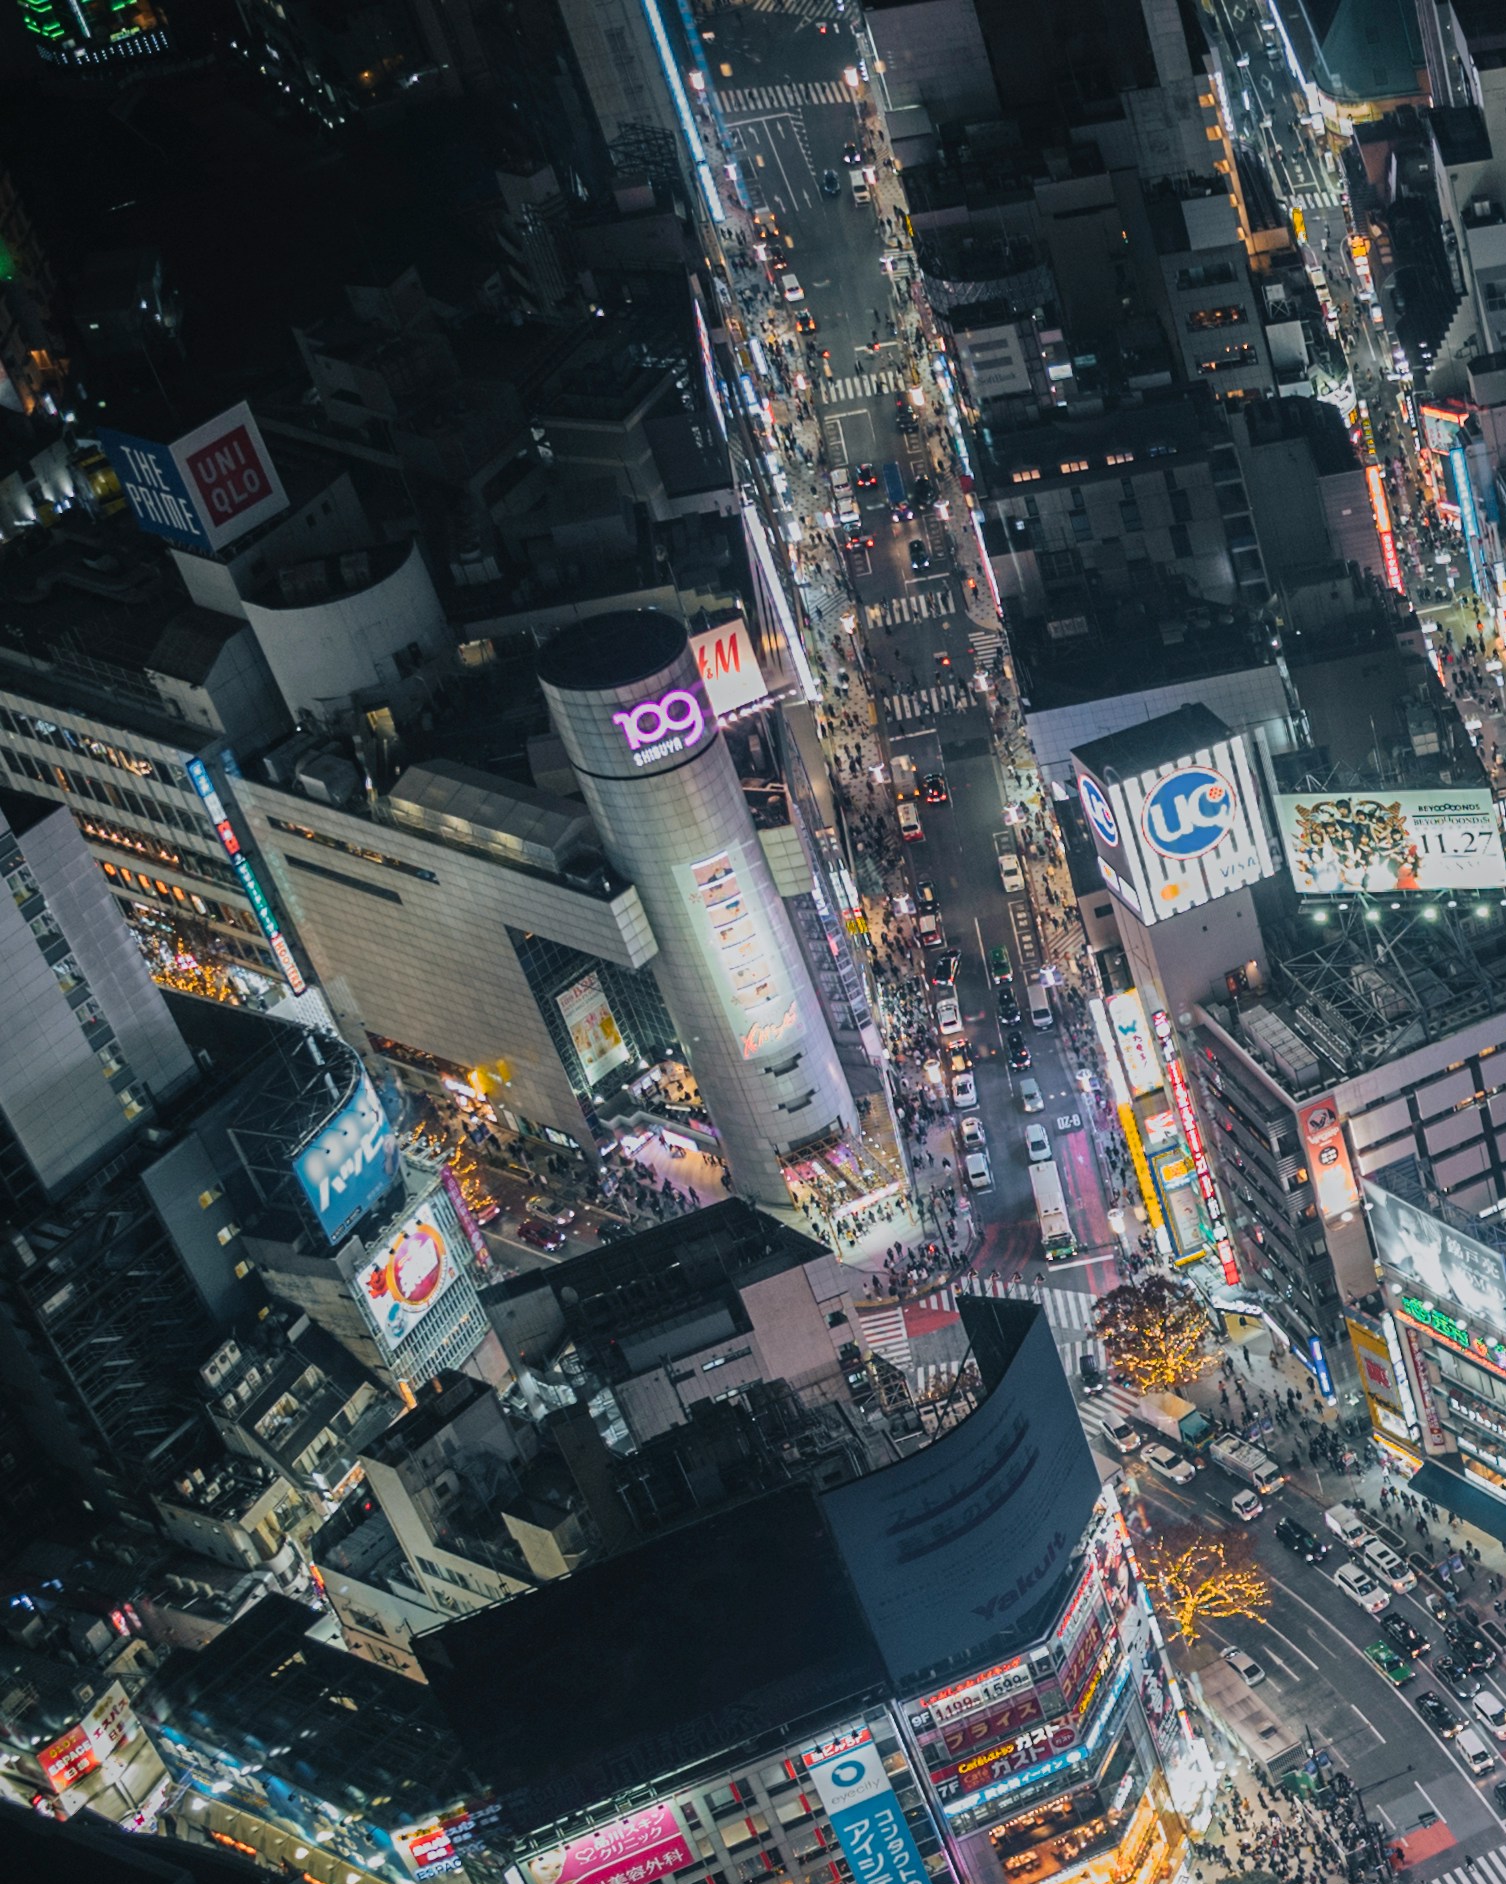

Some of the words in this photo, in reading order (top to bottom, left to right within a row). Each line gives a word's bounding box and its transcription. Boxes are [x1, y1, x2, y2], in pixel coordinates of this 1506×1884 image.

[120, 445, 171, 491] THE
[198, 441, 246, 485] UNI
[126, 482, 200, 535] PRIME
[211, 468, 261, 513] QLO
[613, 689, 705, 751] 109
[633, 736, 684, 767] SHIBUYA
[1151, 783, 1231, 842] UC
[1421, 831, 1494, 855] 11.27
[1222, 856, 1256, 878] VISA
[274, 940, 306, 990] HOOTERS
[970, 1530, 1067, 1621] Yakult
[911, 1711, 930, 1728] 9F
[1014, 1724, 1060, 1752] ガスト
[991, 1746, 1046, 1779] ガスト
[831, 1777, 881, 1805] eyecity
[938, 1782, 959, 1798] 7F
[593, 1812, 665, 1850] 品川スキン
[599, 1827, 663, 1861] クリニック
